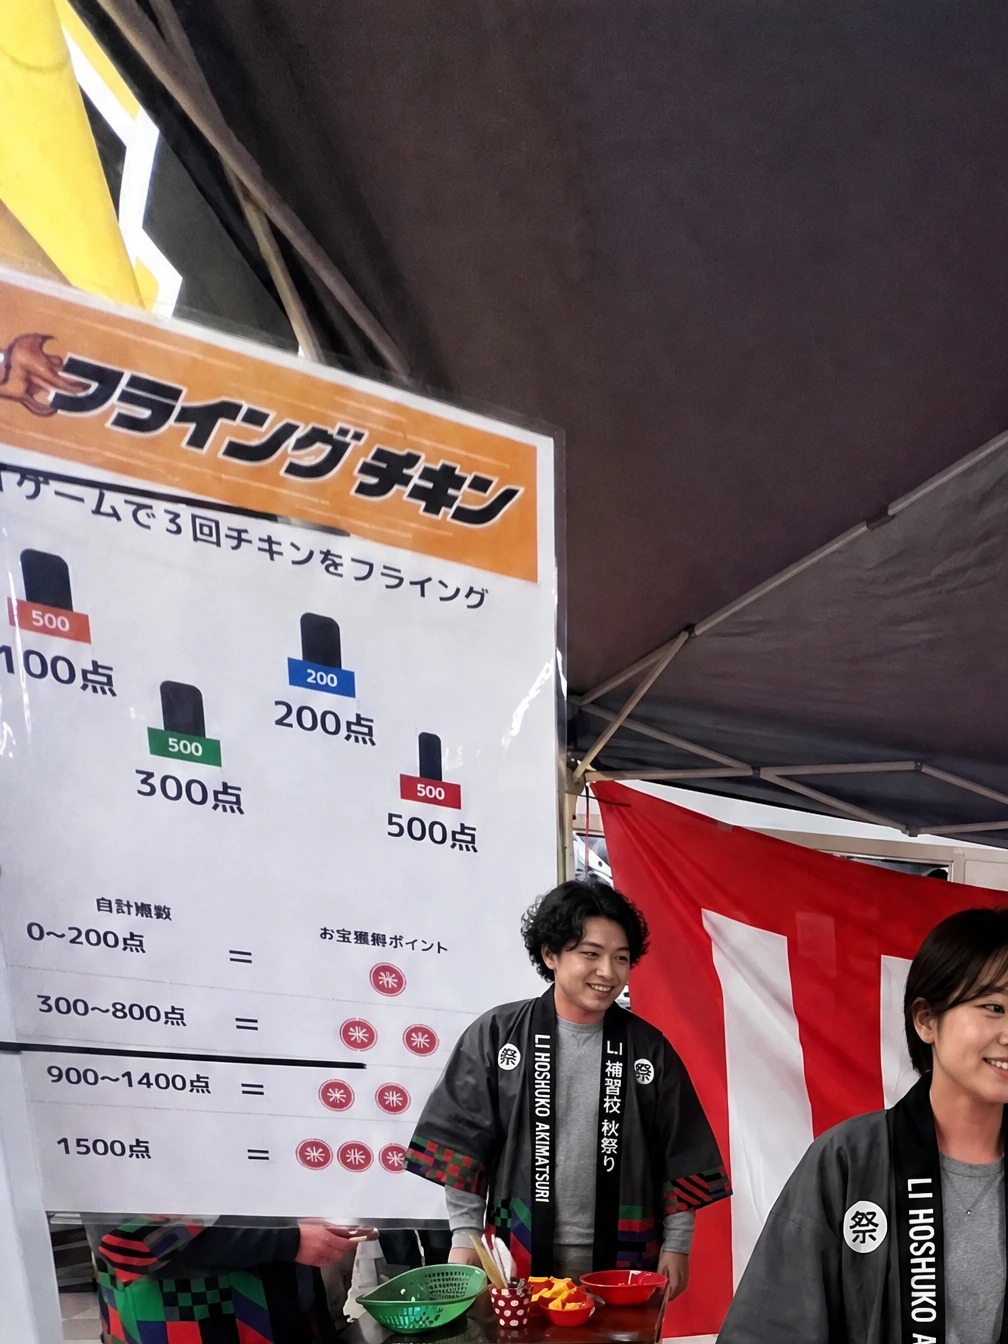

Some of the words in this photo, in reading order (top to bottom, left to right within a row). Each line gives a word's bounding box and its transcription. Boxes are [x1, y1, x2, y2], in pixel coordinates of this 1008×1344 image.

[0, 471, 489, 610] ゲームで3回チキンをフライング
[32, 609, 70, 633] 500
[0, 644, 117, 697] 100点
[305, 669, 338, 690] 200
[275, 700, 376, 746] 200点
[167, 737, 203, 758] 500
[135, 768, 244, 814] 300点
[416, 782, 446, 802] 500
[387, 813, 478, 852] 500点
[534, 1034, 551, 1049] LI
[534, 1052, 551, 1117] HOSHUKO
[600, 1059, 623, 1114] 補習校
[56, 1137, 152, 1160] 1500点
[535, 1121, 550, 1203] AKIMATSURI
[600, 1119, 620, 1172] 秋祭り
[907, 1178, 933, 1199] LI
[849, 1210, 880, 1245] 祭
[908, 1208, 937, 1323] HOSHUKO
